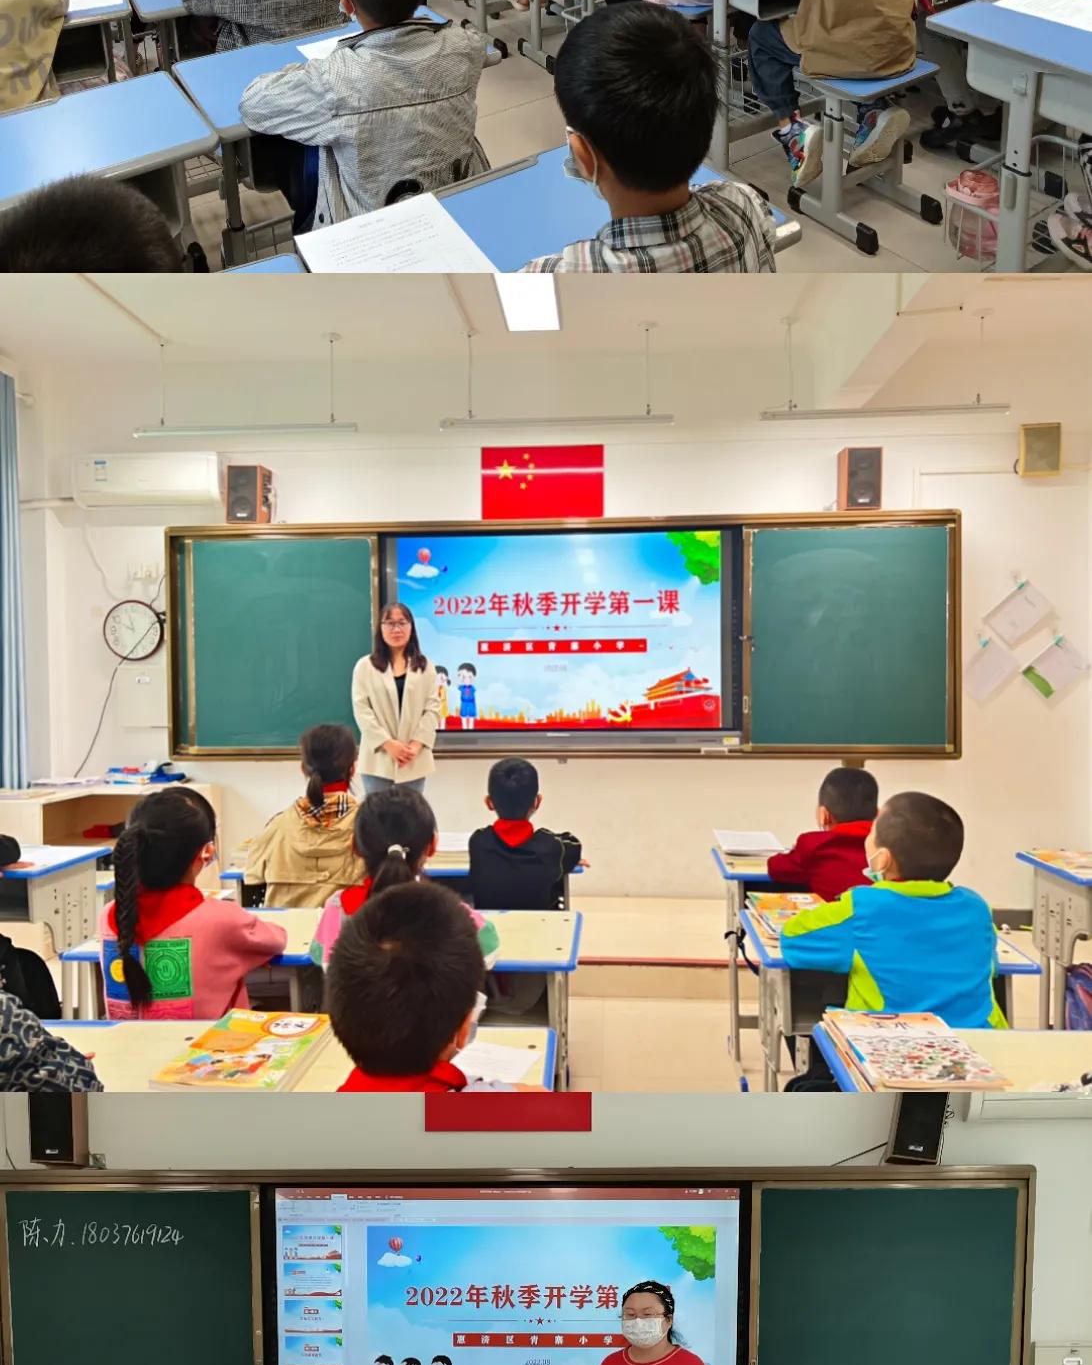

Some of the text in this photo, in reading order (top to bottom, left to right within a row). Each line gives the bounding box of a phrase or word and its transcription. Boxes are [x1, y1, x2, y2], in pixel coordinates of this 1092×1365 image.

[433, 588, 680, 617] 2022年秋季开学第一课
